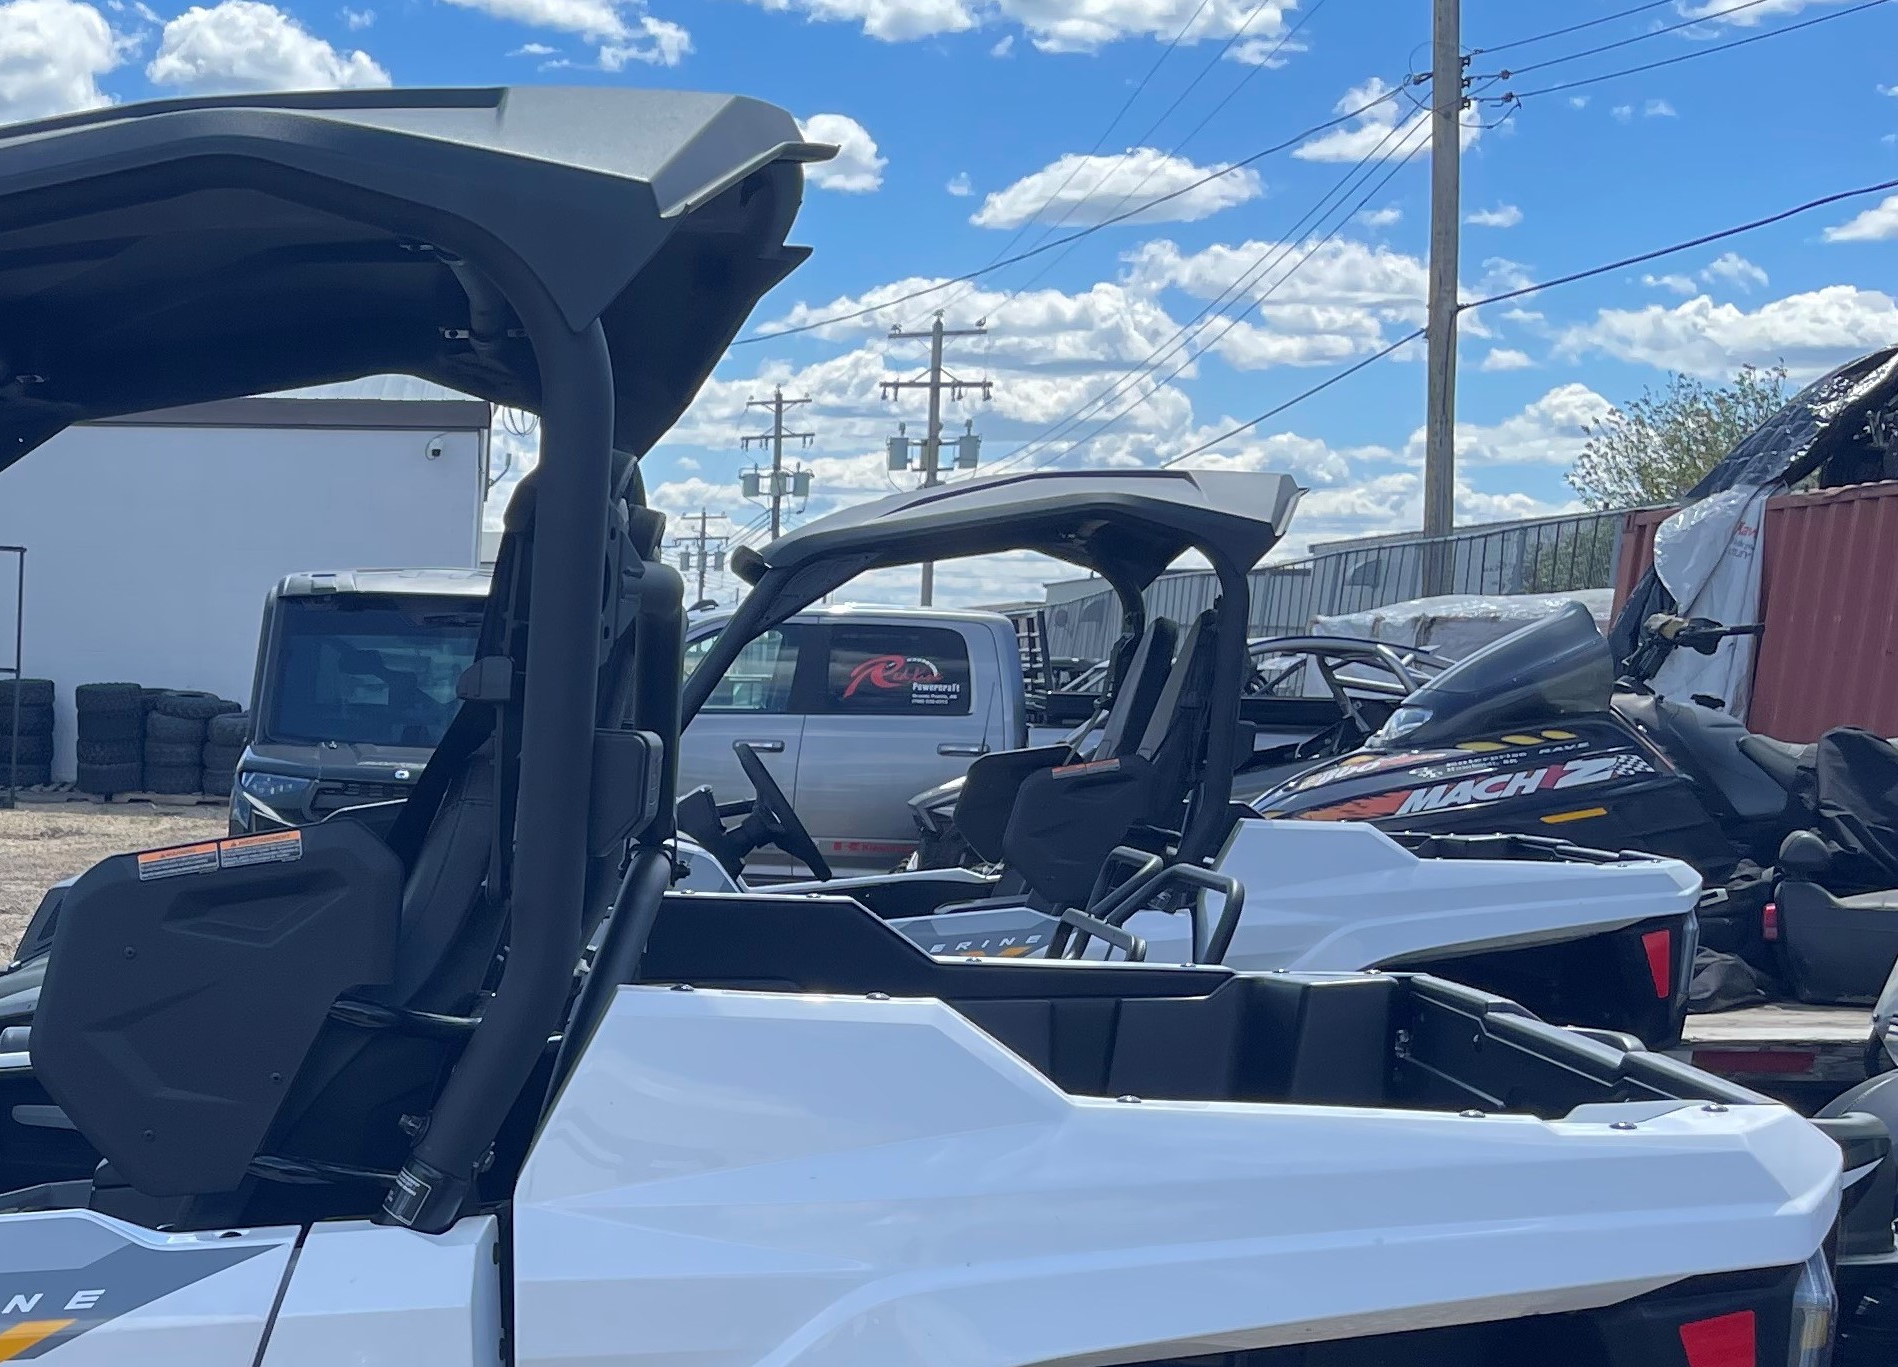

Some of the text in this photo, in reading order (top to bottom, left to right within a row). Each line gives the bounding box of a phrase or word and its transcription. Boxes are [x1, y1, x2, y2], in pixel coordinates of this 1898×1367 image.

[1395, 767, 1549, 816] MACH
[1554, 756, 1620, 790] Z
[929, 934, 1043, 954] ERINE
